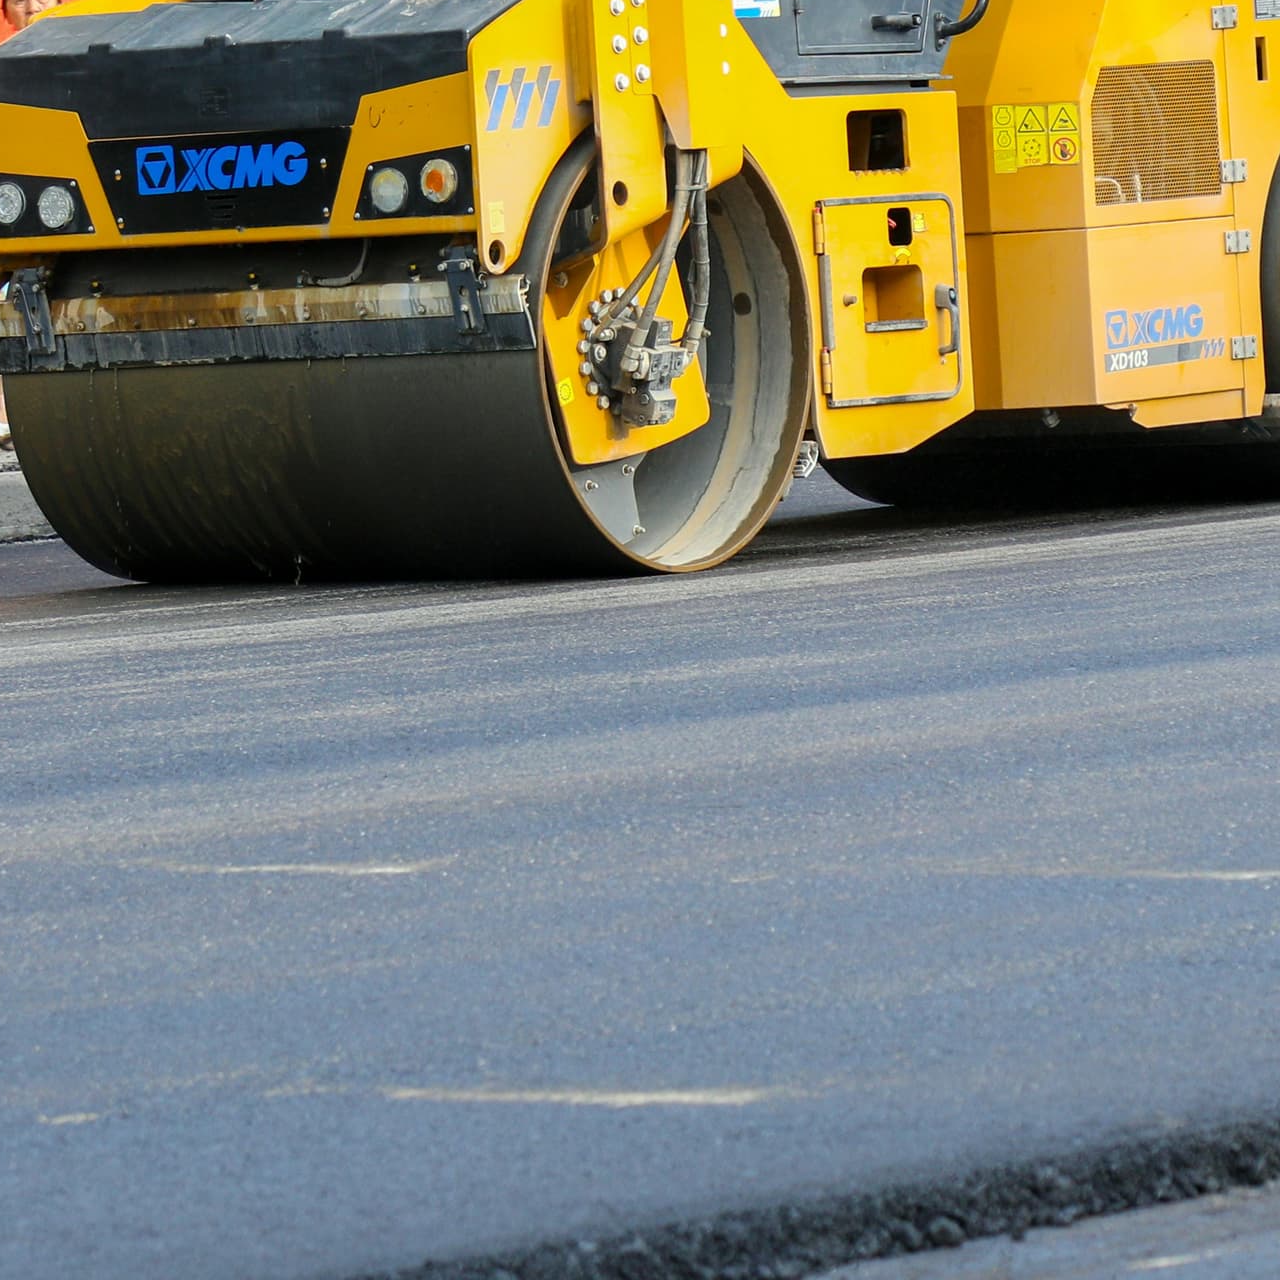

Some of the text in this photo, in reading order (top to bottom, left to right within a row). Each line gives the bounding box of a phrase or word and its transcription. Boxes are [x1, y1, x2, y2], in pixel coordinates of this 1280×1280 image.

[175, 142, 309, 193] XCMG
[1130, 304, 1204, 346] XCMG
[1110, 349, 1149, 372] XD103
